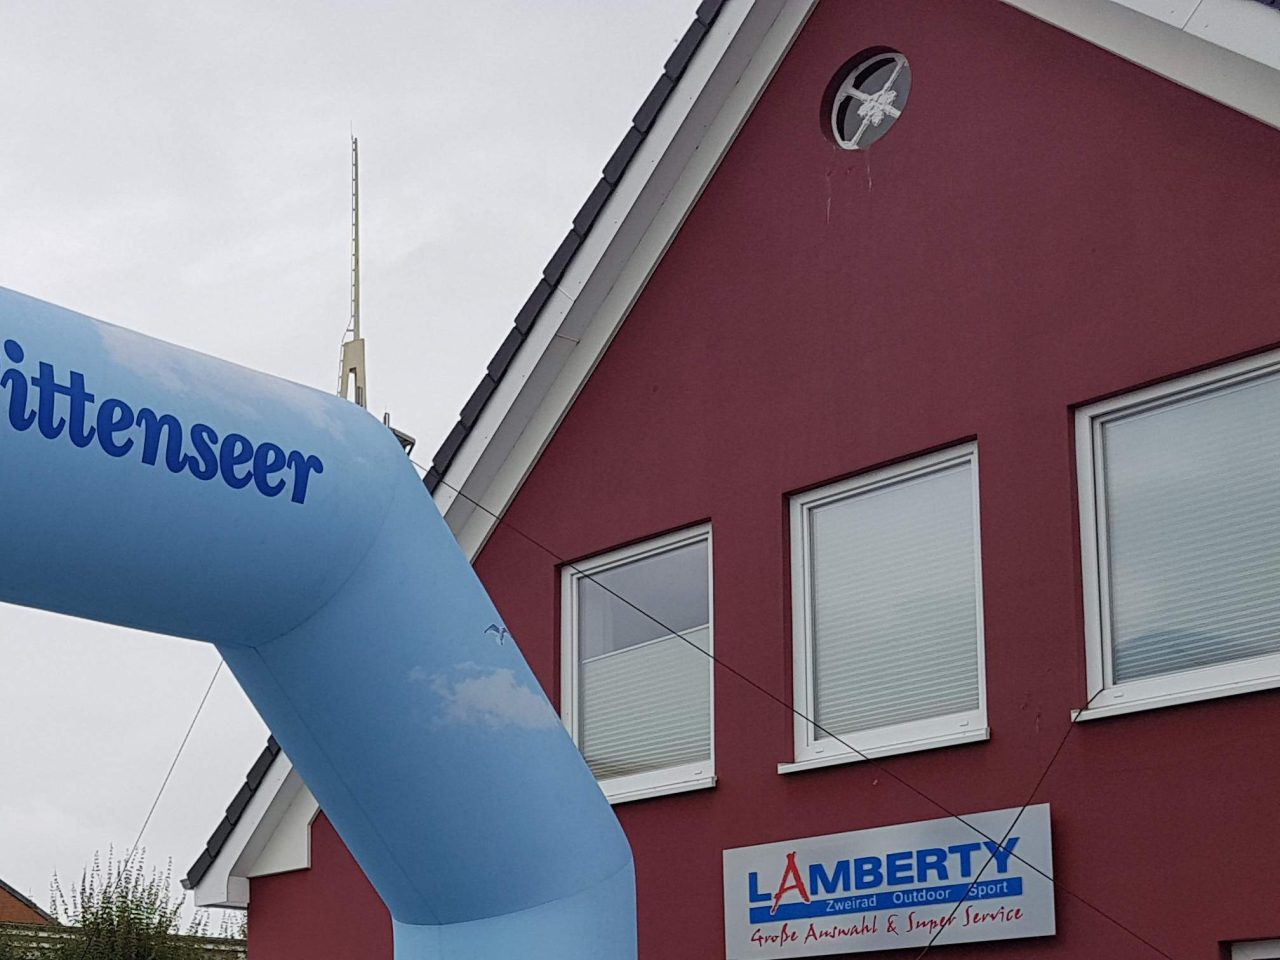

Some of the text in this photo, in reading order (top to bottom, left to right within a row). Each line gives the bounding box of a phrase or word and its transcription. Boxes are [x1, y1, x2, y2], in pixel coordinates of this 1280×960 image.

[748, 836, 1021, 913] LAMBERTY
[826, 880, 1009, 913] Zweirad Outdoor Sport
[750, 904, 1024, 947] Große Auswahl & Super Service
